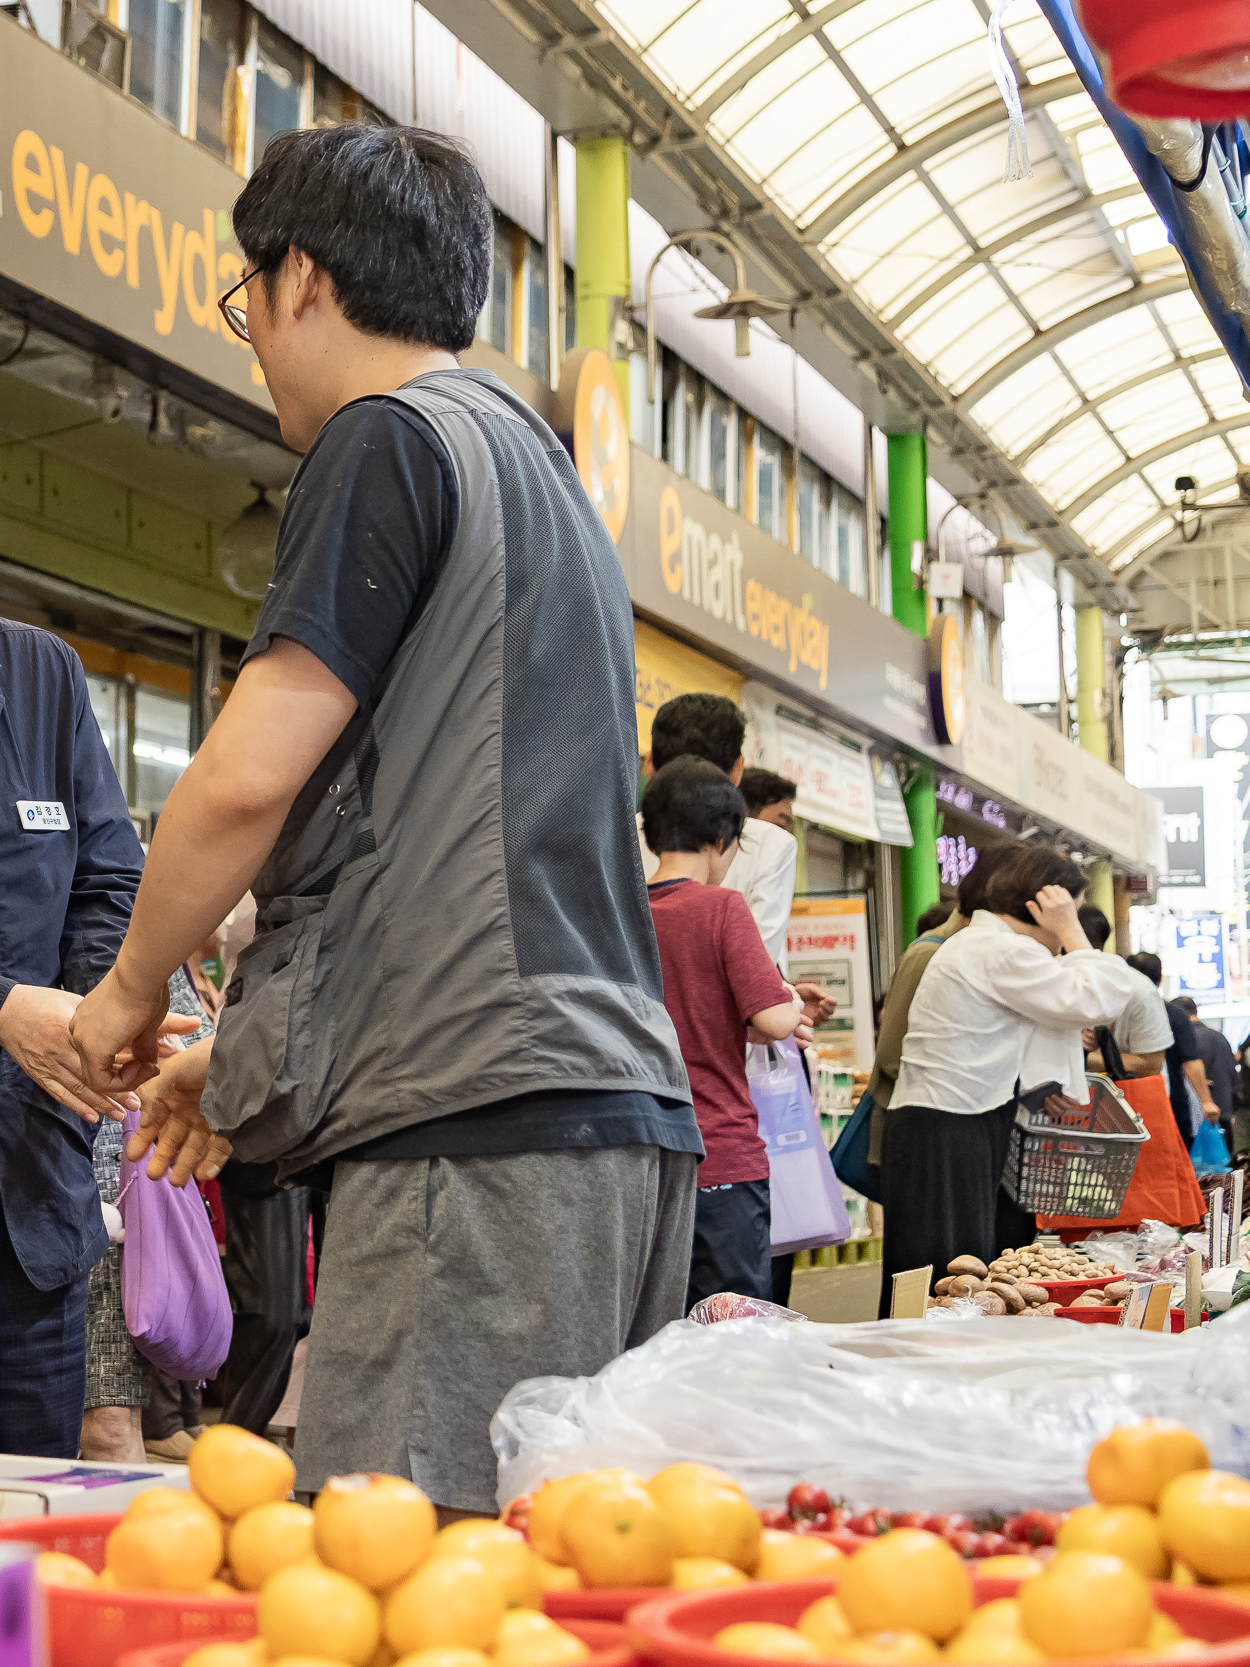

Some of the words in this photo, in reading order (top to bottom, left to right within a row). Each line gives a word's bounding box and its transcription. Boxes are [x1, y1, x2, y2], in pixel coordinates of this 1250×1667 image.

[11, 129, 267, 387] everyda
[660, 486, 747, 633] emart
[745, 578, 830, 690] everyday
[35, 806, 62, 816] 김경호
